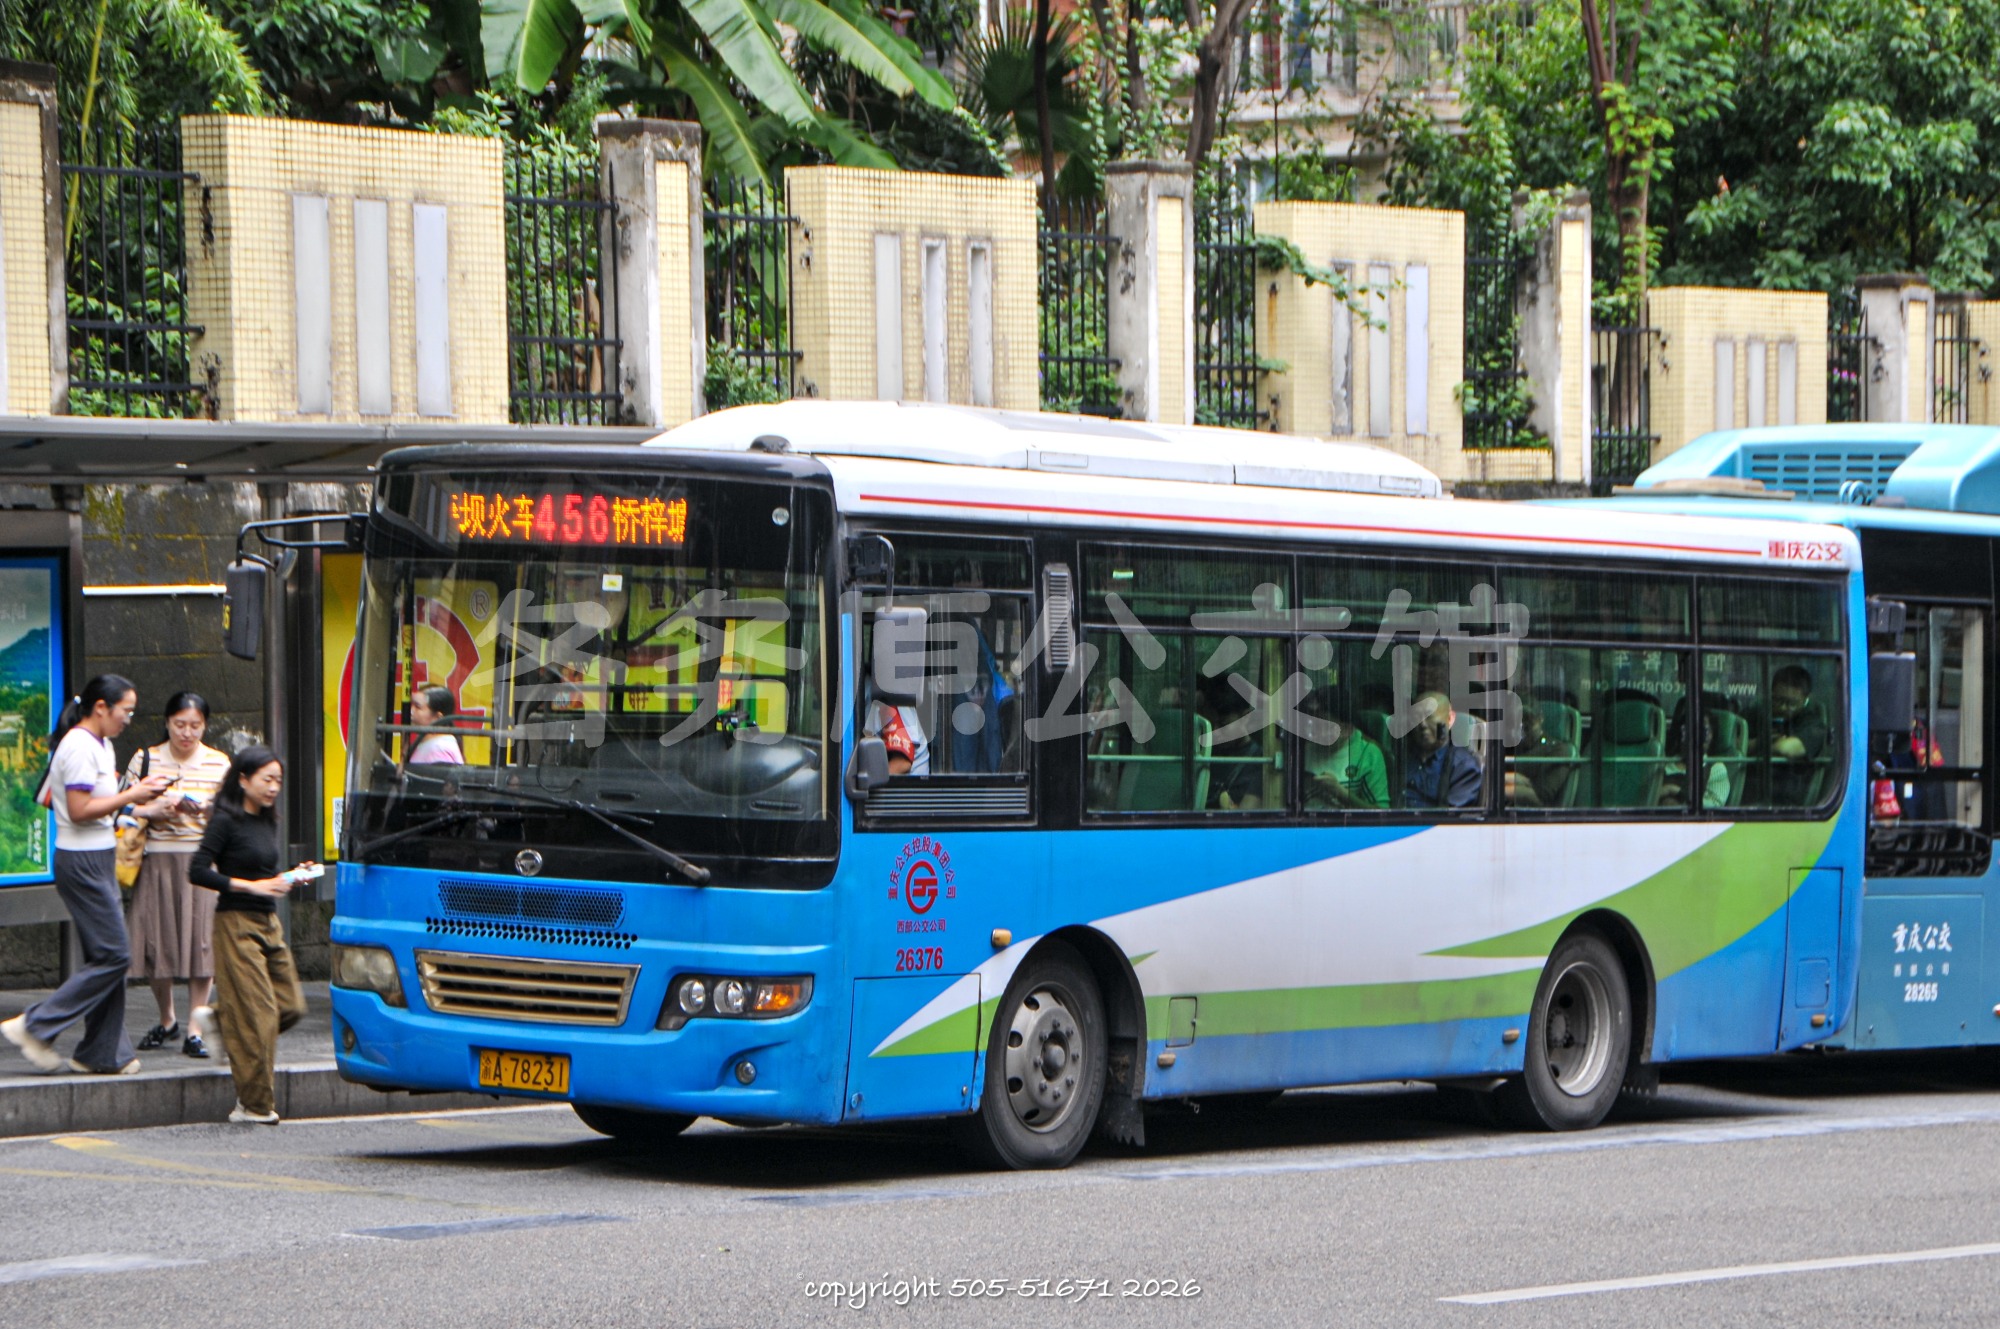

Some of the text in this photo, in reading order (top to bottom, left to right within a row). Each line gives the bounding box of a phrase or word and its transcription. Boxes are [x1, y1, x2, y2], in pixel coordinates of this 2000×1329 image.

[536, 494, 609, 542] 456
[1768, 541, 1842, 561] 重庆公交
[897, 919, 946, 933] 西部公交公司
[896, 947, 943, 971] 26376
[1904, 982, 1938, 1002] 28265
